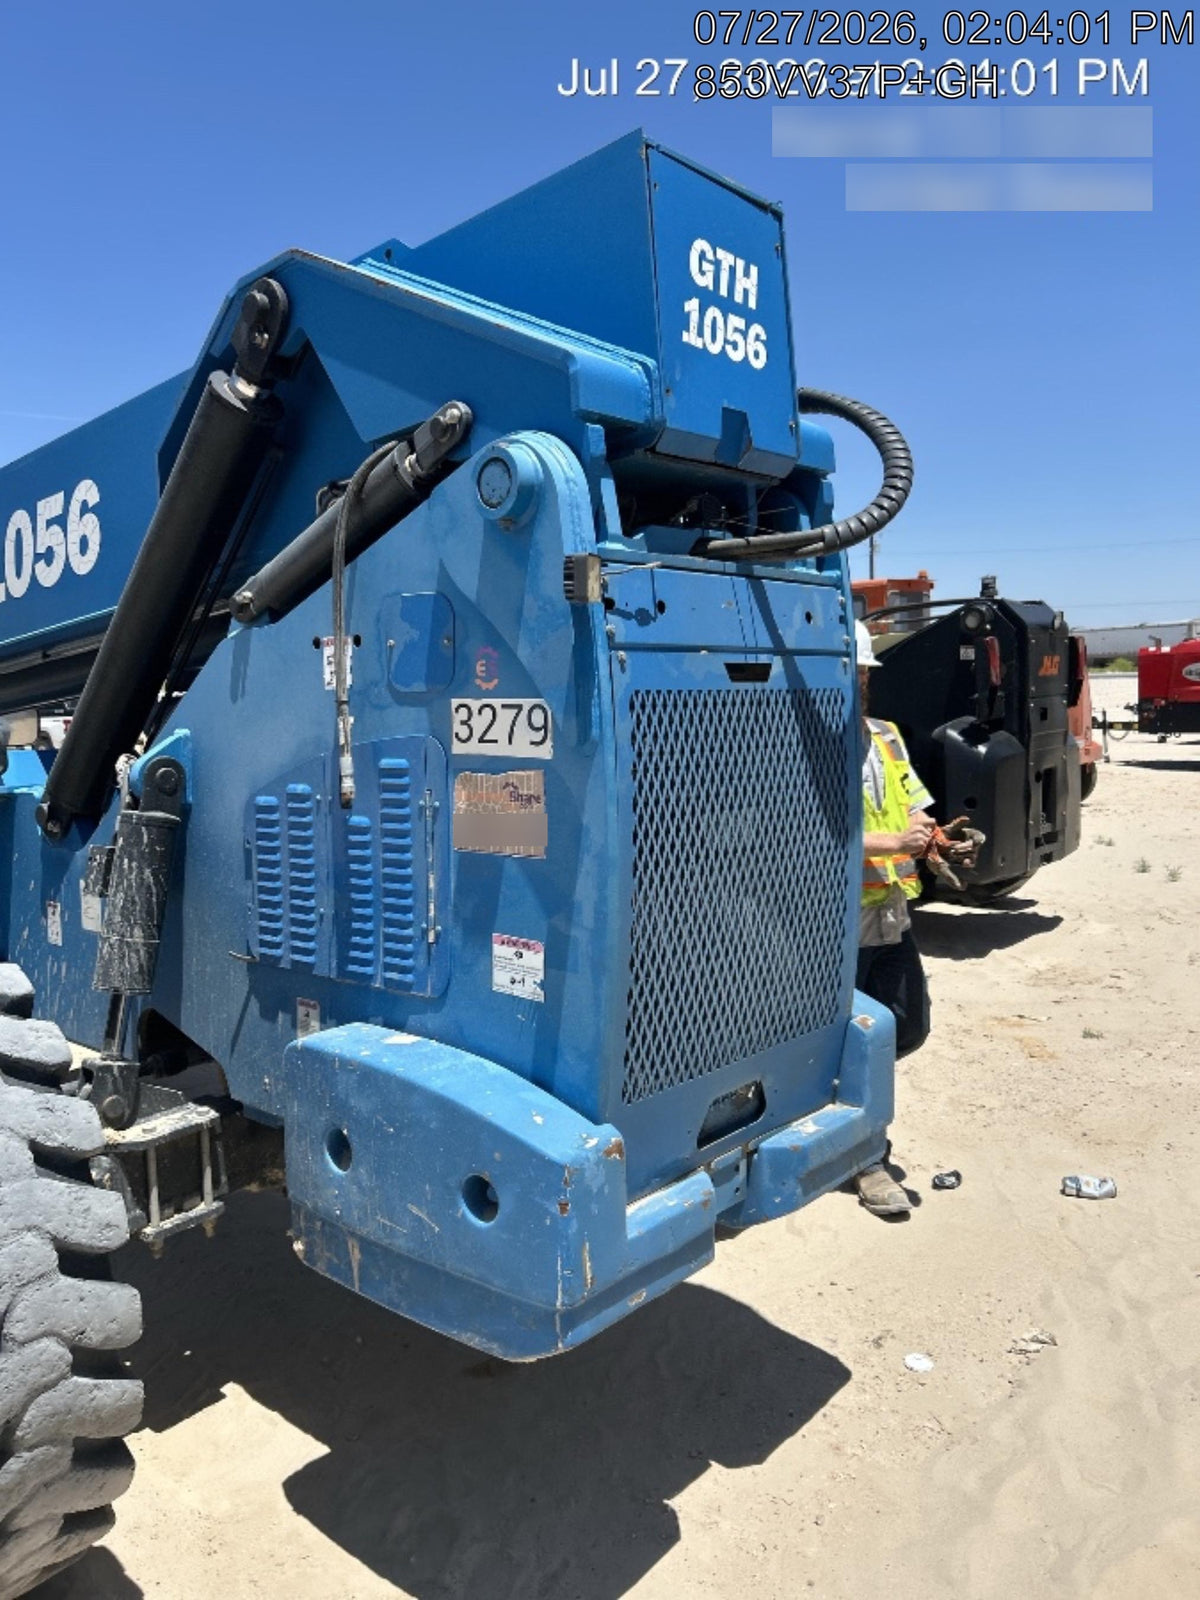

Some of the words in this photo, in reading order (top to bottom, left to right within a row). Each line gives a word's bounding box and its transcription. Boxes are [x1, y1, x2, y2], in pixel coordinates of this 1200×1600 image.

[689, 237, 759, 311] GTH
[681, 297, 768, 370] 1056
[0, 479, 101, 603] 056
[453, 703, 550, 746] 3279
